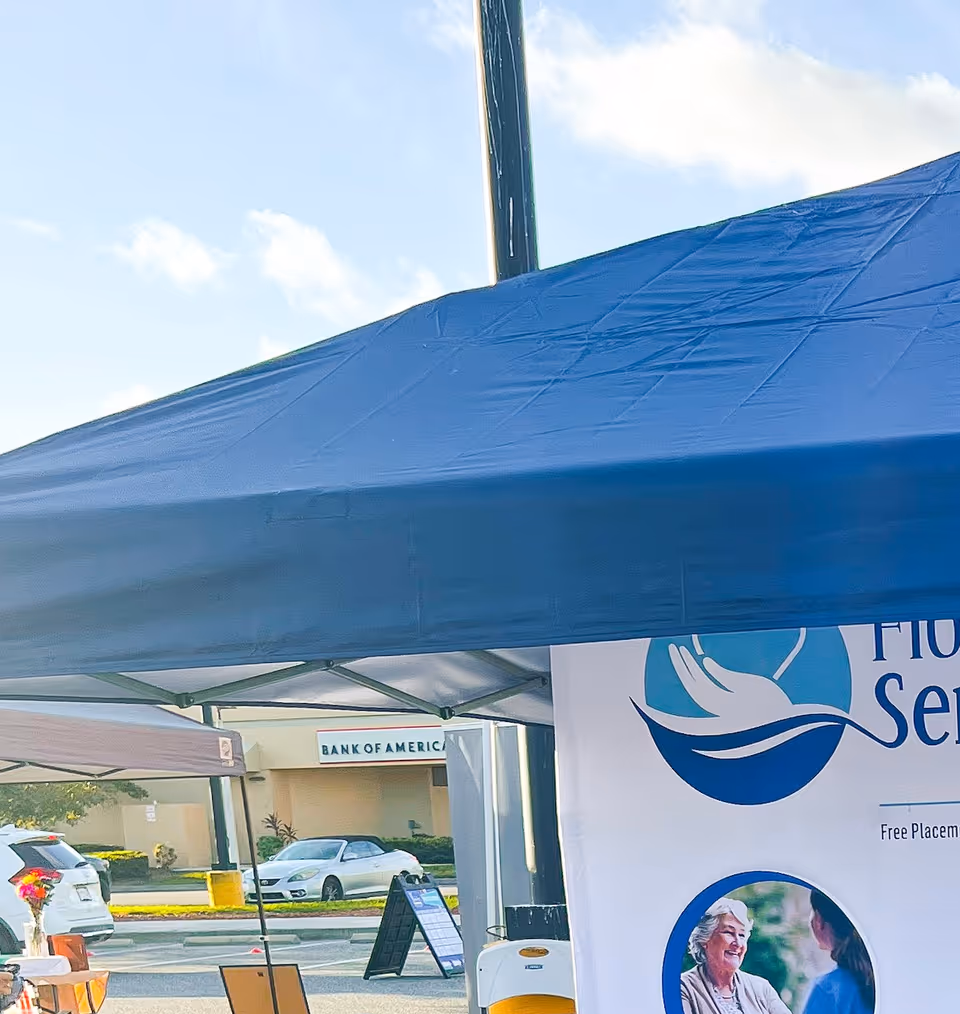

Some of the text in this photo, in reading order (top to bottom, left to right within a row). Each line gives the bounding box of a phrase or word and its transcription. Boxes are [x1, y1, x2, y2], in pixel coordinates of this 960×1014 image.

[321, 743, 360, 756] BANK
[363, 743, 382, 754] OF
[880, 823, 908, 841] Free
